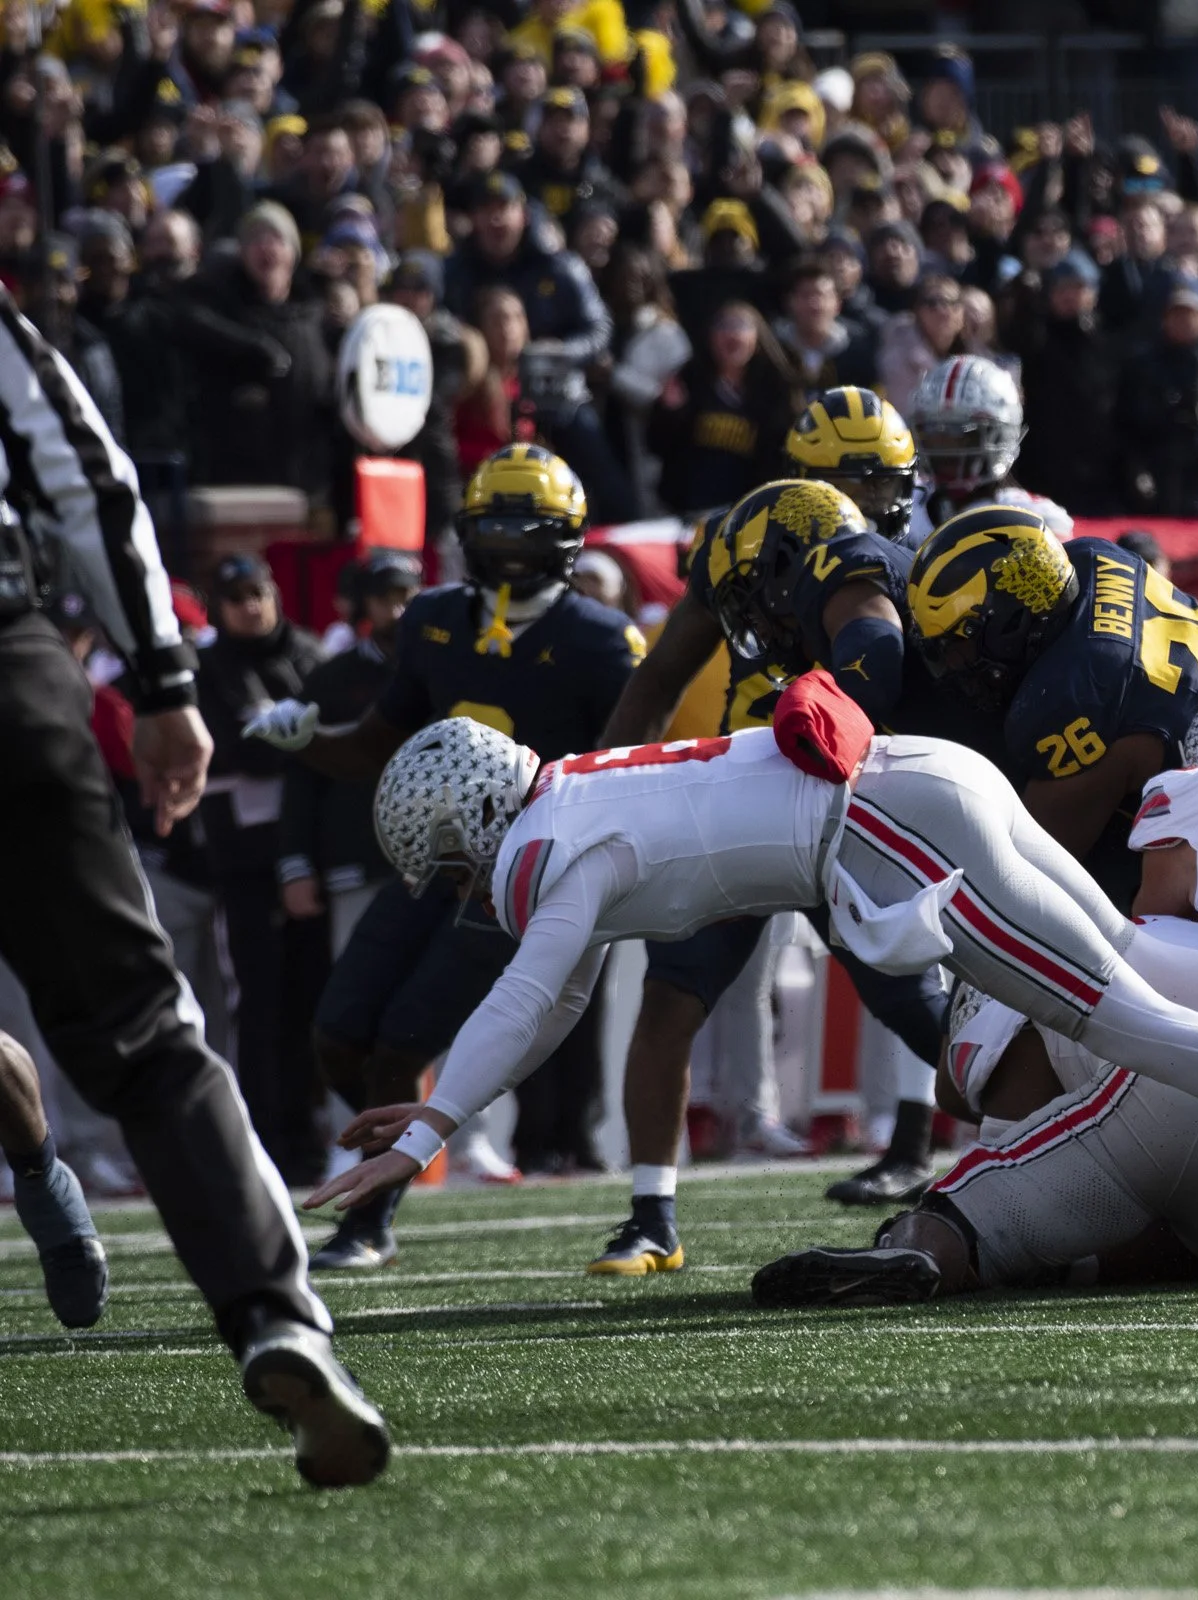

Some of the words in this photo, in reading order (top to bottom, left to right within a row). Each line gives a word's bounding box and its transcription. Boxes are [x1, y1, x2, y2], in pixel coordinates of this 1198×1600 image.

[804, 544, 843, 582] 2
[1094, 554, 1136, 639] BENNY
[1036, 717, 1107, 777] 26
